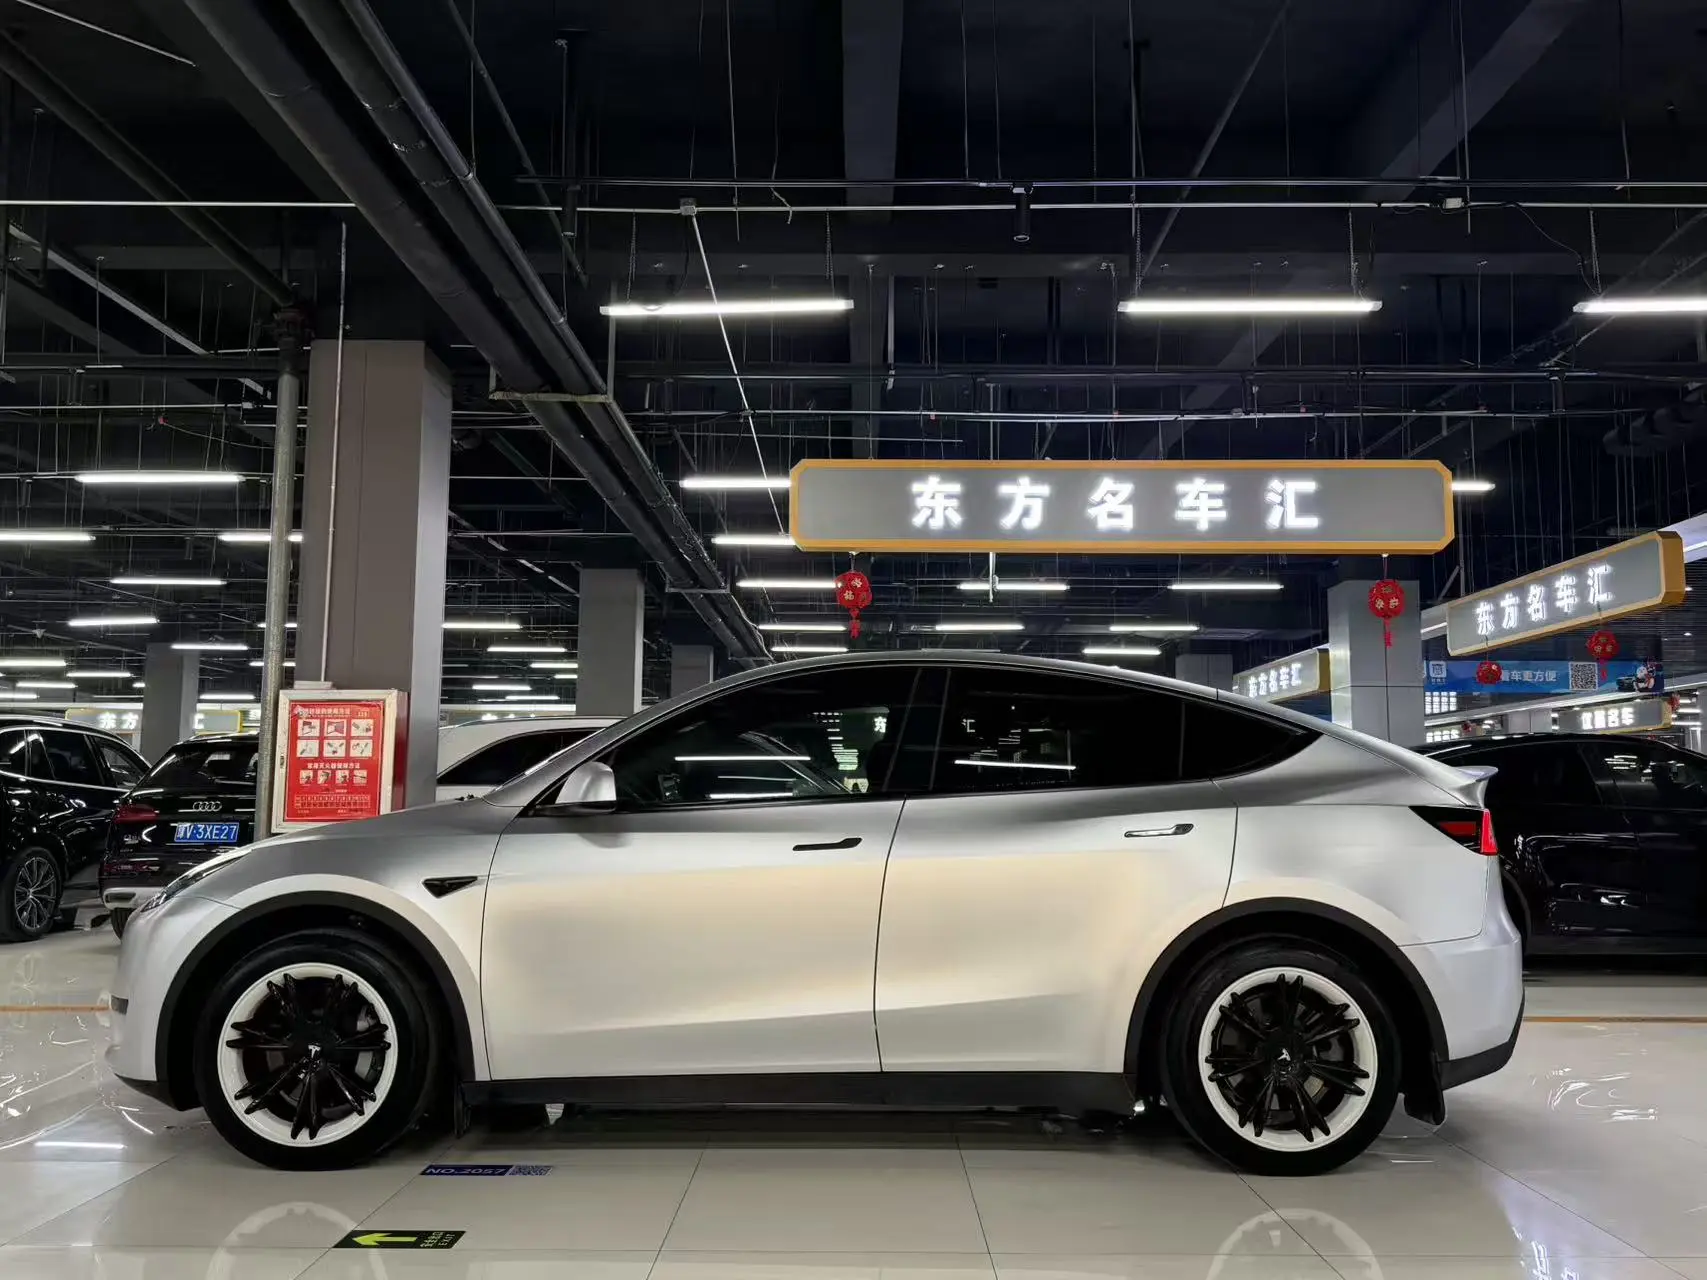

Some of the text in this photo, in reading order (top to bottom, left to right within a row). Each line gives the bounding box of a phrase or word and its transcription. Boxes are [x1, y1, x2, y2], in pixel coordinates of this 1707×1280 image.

[910, 475, 1320, 531] 东方名车汇
[1475, 563, 1614, 635] 东方名车汇
